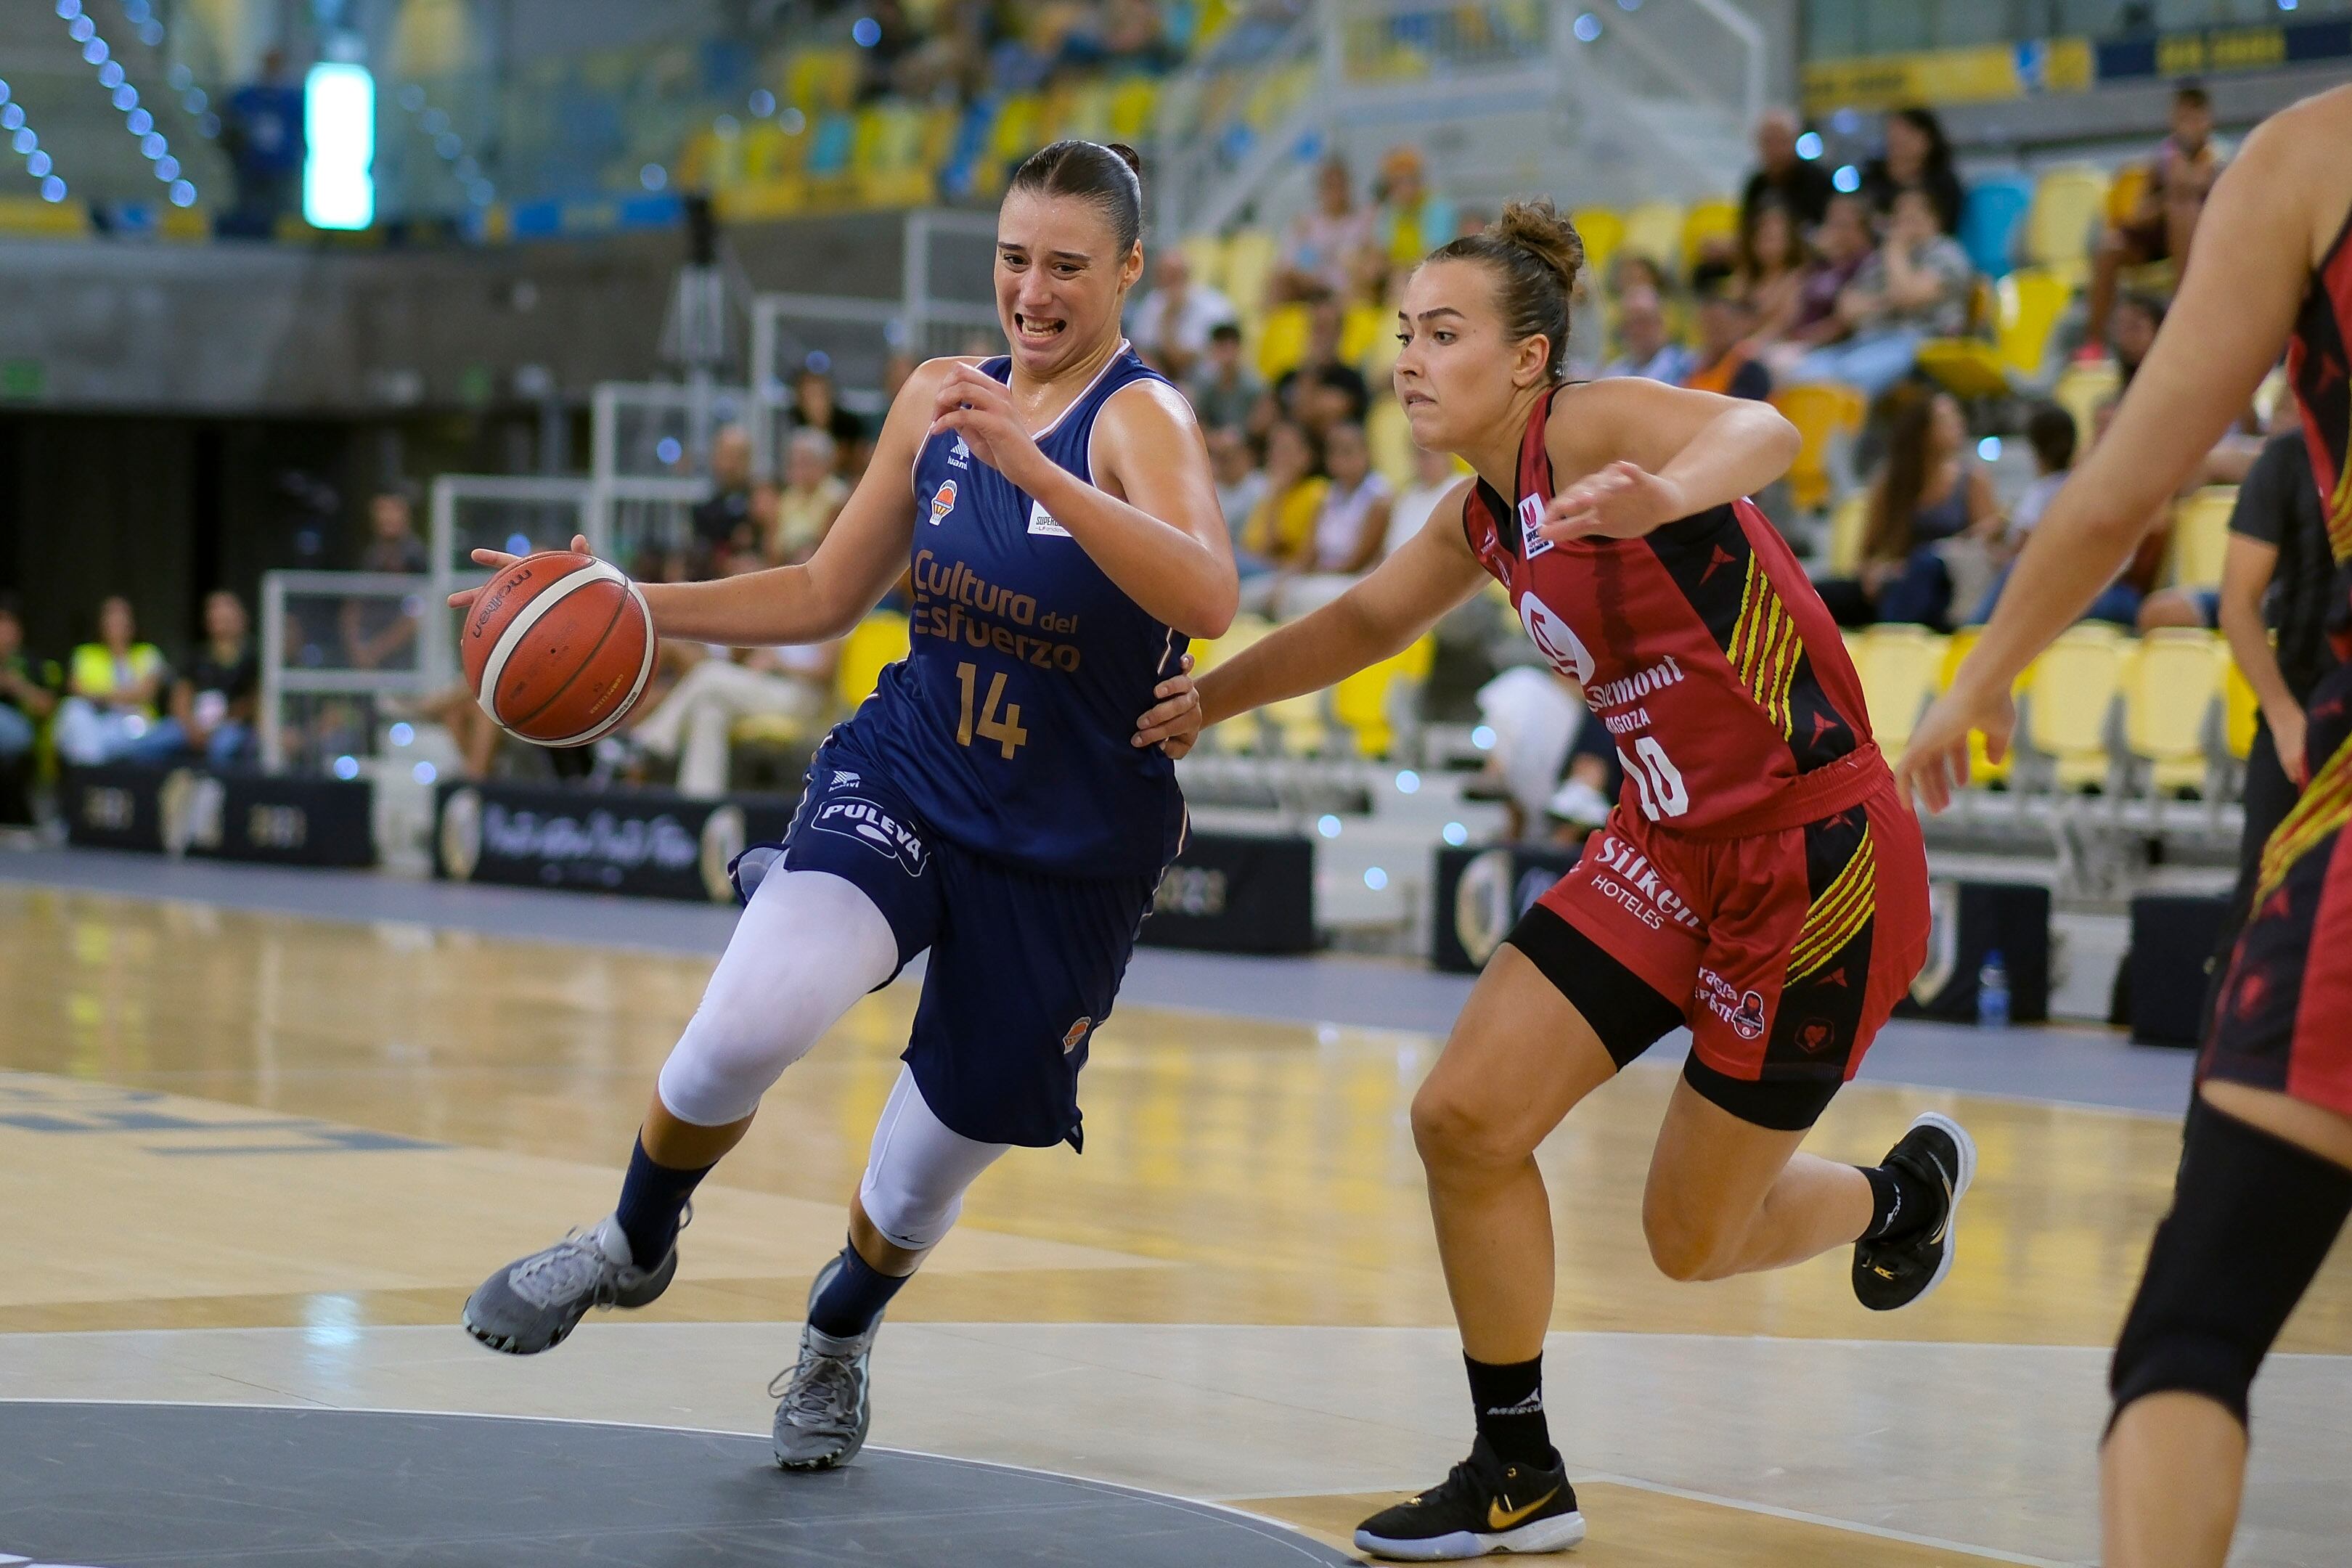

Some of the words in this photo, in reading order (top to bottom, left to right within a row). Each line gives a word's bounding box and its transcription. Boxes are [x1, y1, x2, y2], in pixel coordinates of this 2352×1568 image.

[472, 568, 532, 639] molten
[915, 549, 1037, 626] Cultura
[1040, 611, 1078, 634] del
[915, 592, 1080, 672] Esfuerzo
[955, 661, 1027, 760] 14
[1616, 736, 1689, 821] 10
[821, 804, 921, 862] PULEVA
[1591, 874, 1665, 930] HOTELES
